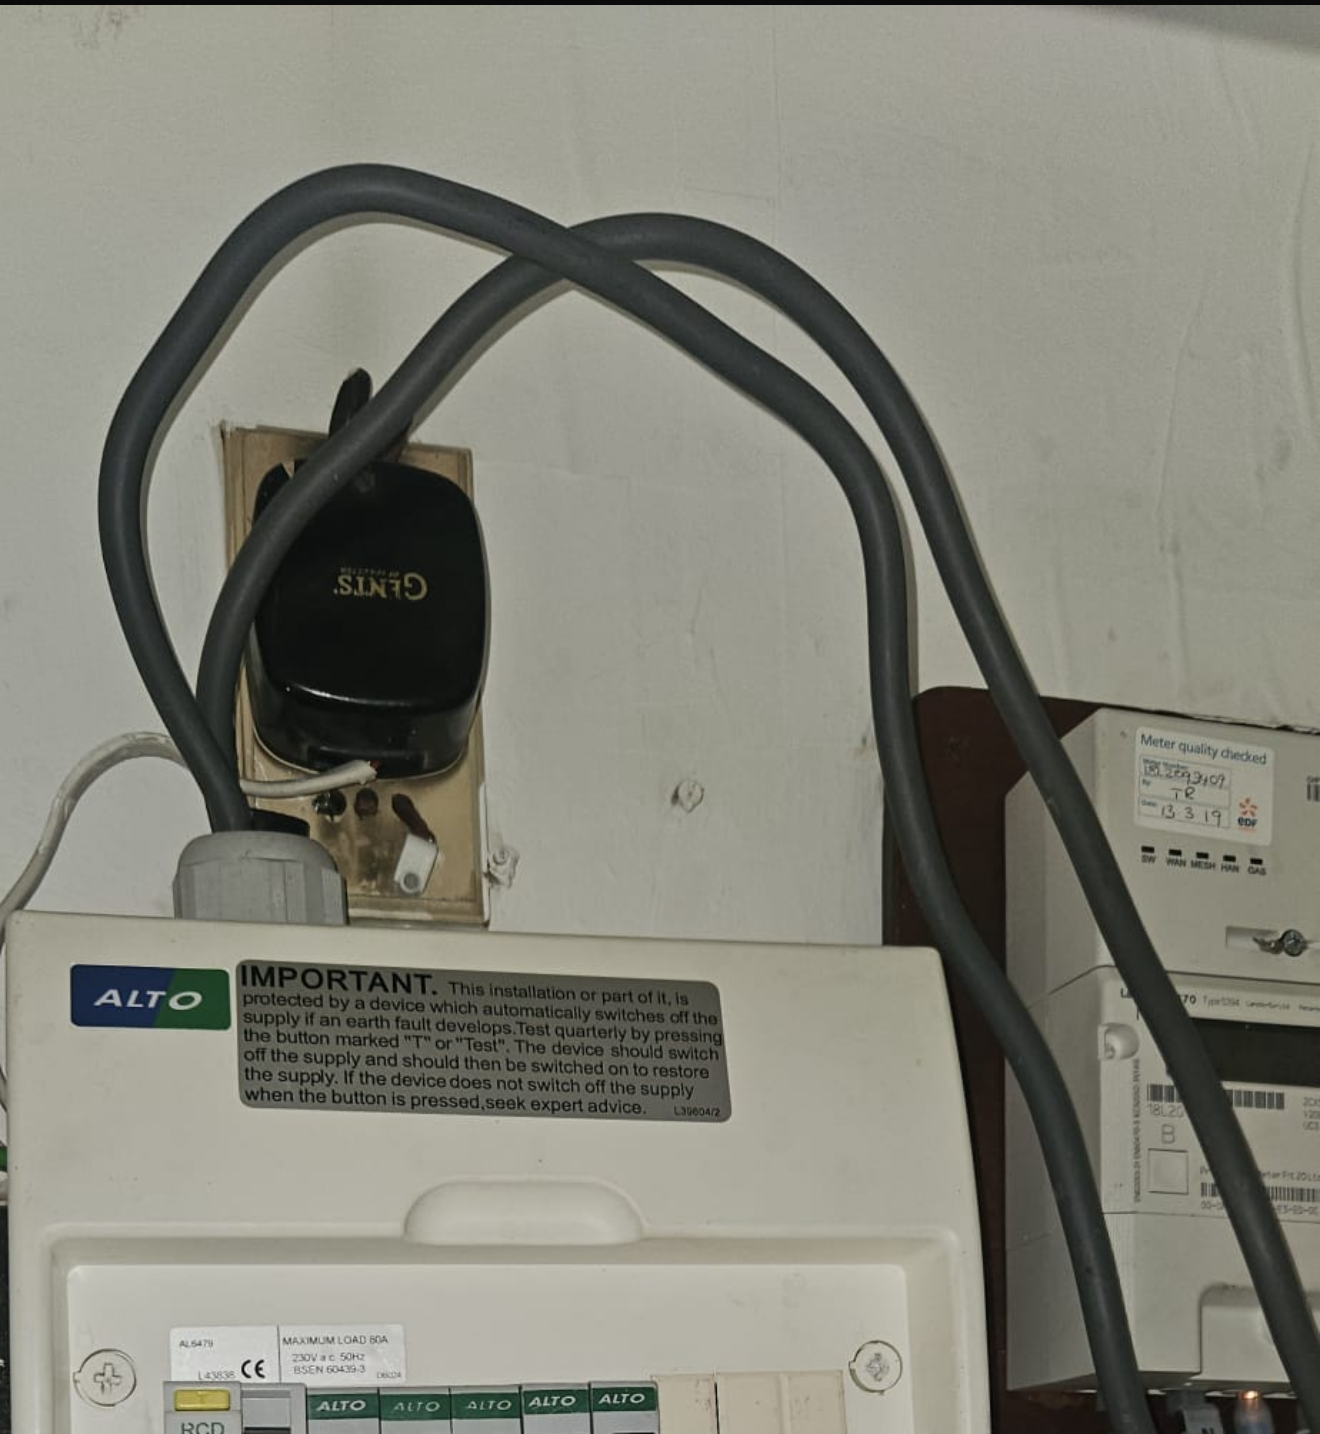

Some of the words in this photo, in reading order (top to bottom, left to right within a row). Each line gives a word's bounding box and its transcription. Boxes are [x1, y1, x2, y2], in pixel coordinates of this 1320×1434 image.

[1141, 733, 1175, 750] Meter
[1178, 739, 1219, 759] quality
[1220, 745, 1267, 765] checked
[1184, 806, 1195, 819] 3
[1205, 808, 1222, 829] 19
[1141, 855, 1156, 864] SW
[1166, 857, 1187, 868] WAN
[1190, 859, 1216, 870] MESH
[1221, 863, 1240, 874] HAN
[1247, 865, 1267, 876] GAS
[241, 964, 438, 995] IMPORTANT.
[448, 981, 485, 997] This
[489, 983, 576, 1000] installation
[580, 989, 596, 1001] or
[602, 989, 633, 1006] part
[638, 991, 654, 1004] of
[675, 992, 689, 1006] is
[93, 989, 202, 1011] ALTO
[243, 993, 324, 1010] protected
[329, 994, 350, 1012] by
[355, 1000, 366, 1011] a
[370, 997, 425, 1013] device
[430, 999, 477, 1016] which
[483, 1003, 591, 1023] automatically
[595, 1006, 665, 1024] switches
[670, 1009, 690, 1025] off
[692, 1010, 718, 1026] the
[243, 1011, 300, 1029] supply
[305, 1012, 316, 1026] if
[320, 1015, 341, 1027] an
[346, 1014, 390, 1030] earth
[395, 1015, 432, 1032] fault
[555, 1024, 626, 1043] quarterly
[631, 1026, 649, 1044] by
[655, 1029, 723, 1047] pressing
[243, 1029, 271, 1043] the
[276, 1030, 330, 1046] button
[336, 1033, 399, 1048] marked
[404, 1035, 431, 1049] "T"
[435, 1039, 451, 1051] or
[515, 1039, 547, 1055] The
[552, 1041, 604, 1057] device
[610, 1042, 663, 1059] should
[668, 1045, 719, 1061] switch
[243, 1048, 267, 1063] off
[270, 1048, 298, 1063] the
[303, 1051, 360, 1068] supply
[365, 1052, 398, 1067] and
[402, 1053, 459, 1069] should
[464, 1055, 501, 1072] then
[506, 1058, 527, 1073] be
[531, 1058, 604, 1075] switched
[608, 1064, 629, 1076] on
[633, 1062, 649, 1077] to
[653, 1064, 709, 1079] restore
[244, 1067, 273, 1082] the
[278, 1069, 339, 1087] supply.
[344, 1070, 355, 1085] If
[359, 1071, 387, 1086] the
[391, 1073, 446, 1088] device
[450, 1075, 492, 1090] does
[496, 1077, 523, 1092] not
[528, 1077, 580, 1094] switch
[585, 1079, 605, 1095] off
[610, 1080, 636, 1096] the
[641, 1082, 694, 1100] supply
[245, 1087, 293, 1103] when
[299, 1088, 327, 1104] the
[332, 1089, 387, 1106] button
[392, 1091, 406, 1106] is
[531, 1100, 584, 1115] expert
[588, 1100, 647, 1115] advice.
[283, 1336, 335, 1346] MAXIMUM
[338, 1335, 367, 1345] LOAD
[292, 1353, 317, 1362] 230V
[340, 1352, 365, 1362] 50Hz
[294, 1364, 324, 1375] BSEN
[326, 1364, 366, 1374] 60439-3
[316, 1400, 366, 1412] ALTO
[393, 1400, 440, 1412] ALTO
[467, 1399, 512, 1411] ALTO
[528, 1395, 576, 1407] ALTO
[598, 1393, 646, 1405] ALTO
